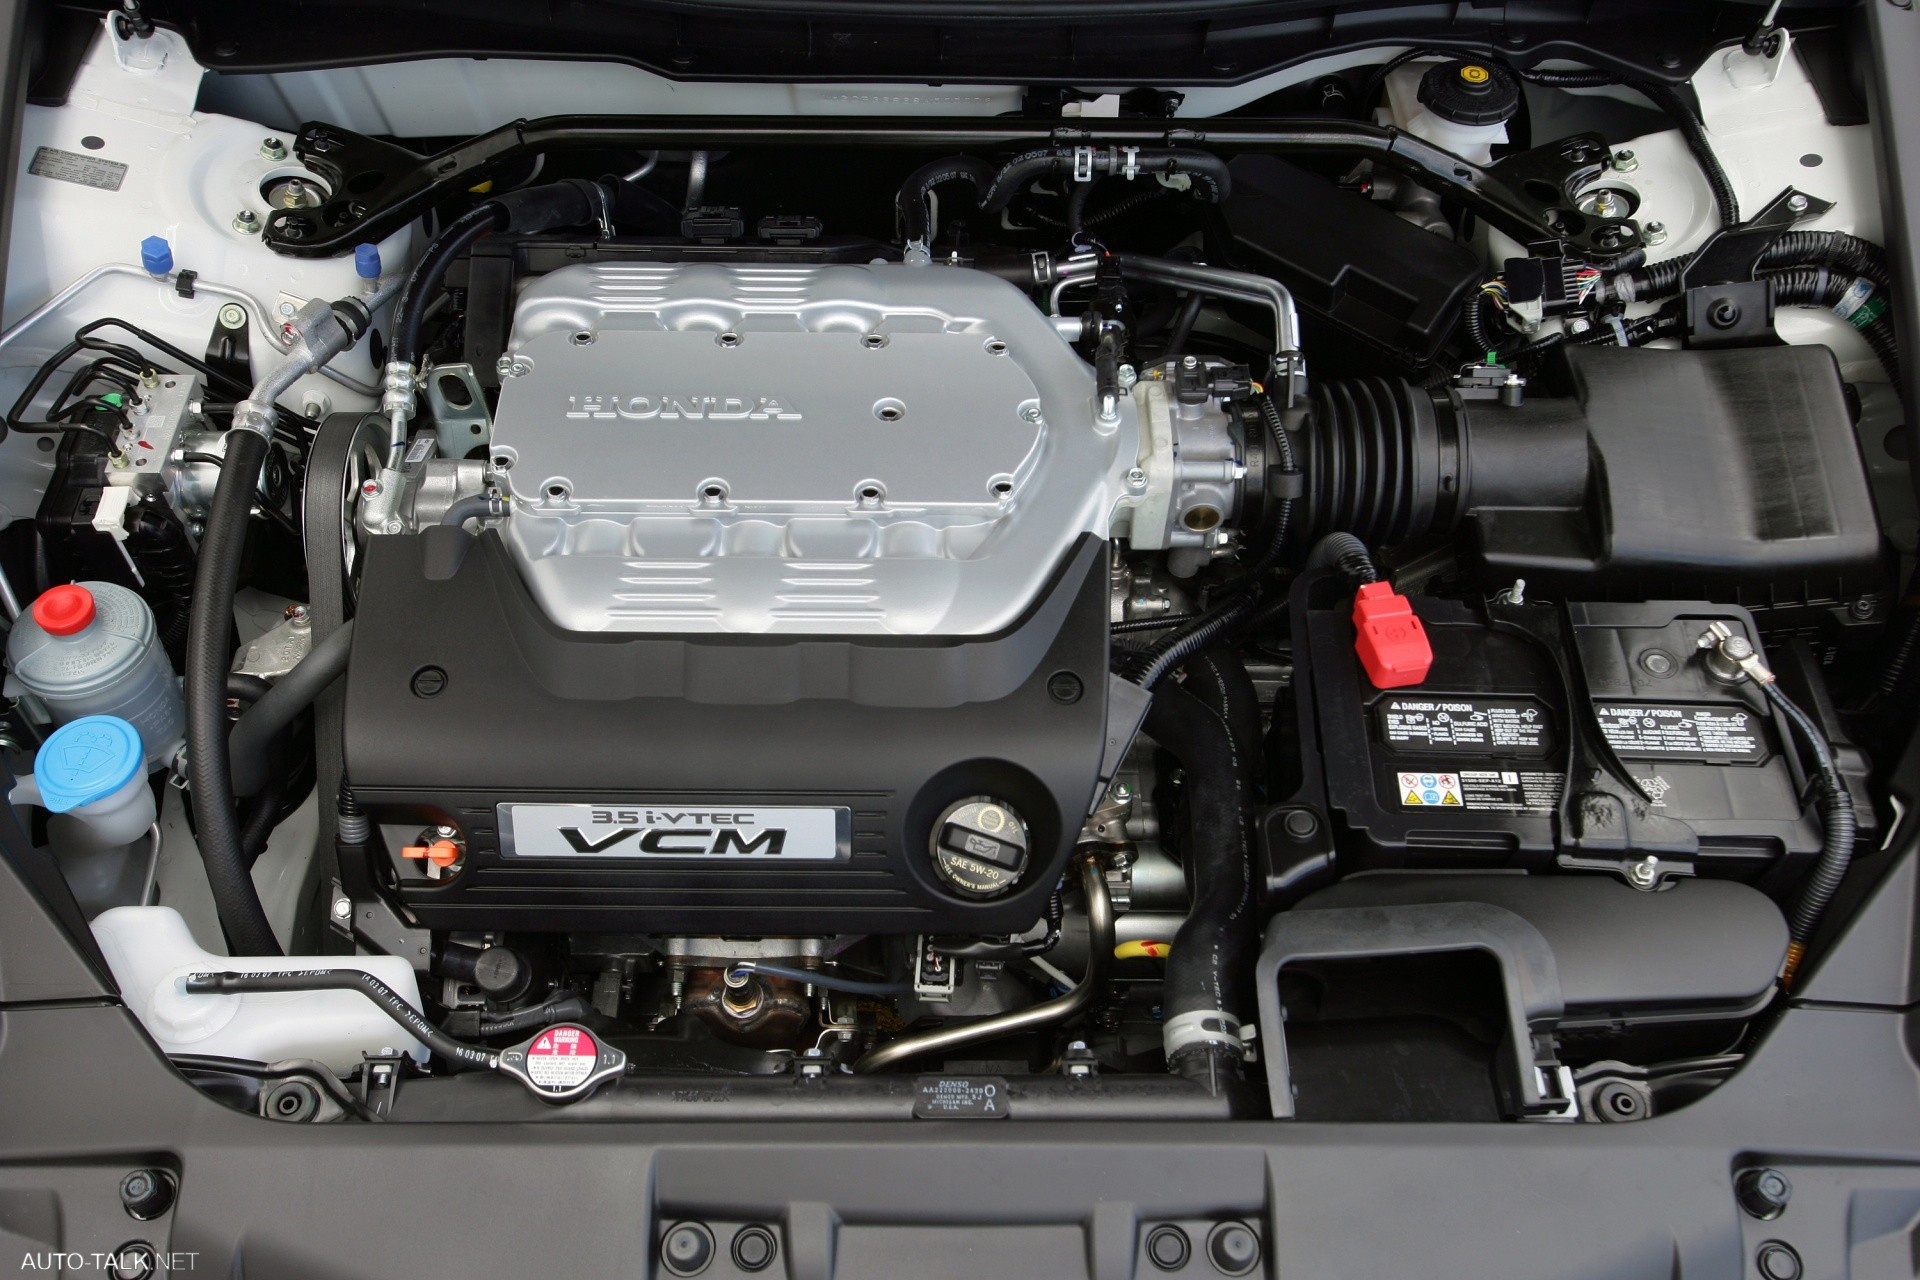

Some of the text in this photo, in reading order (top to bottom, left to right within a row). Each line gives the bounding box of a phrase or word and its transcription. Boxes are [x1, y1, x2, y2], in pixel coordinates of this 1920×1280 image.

[566, 396, 802, 419] HONDA
[1401, 702, 1434, 711] DANGER
[1442, 704, 1473, 712] POISON
[1610, 708, 1644, 716] DANGER
[1651, 710, 1682, 718] POISON
[591, 810, 755, 824] 3.5 i-VTEC
[1008, 821, 1018, 834] OIL
[557, 826, 788, 855] VCM
[951, 857, 999, 880] SAE 5W-20
[944, 864, 1000, 890] SEE OWNER'S MANUAL
[464, 1050, 475, 1059] 03
[476, 1052, 486, 1062] 07
[603, 1054, 616, 1065] 1.1
[984, 1098, 995, 1111] A
